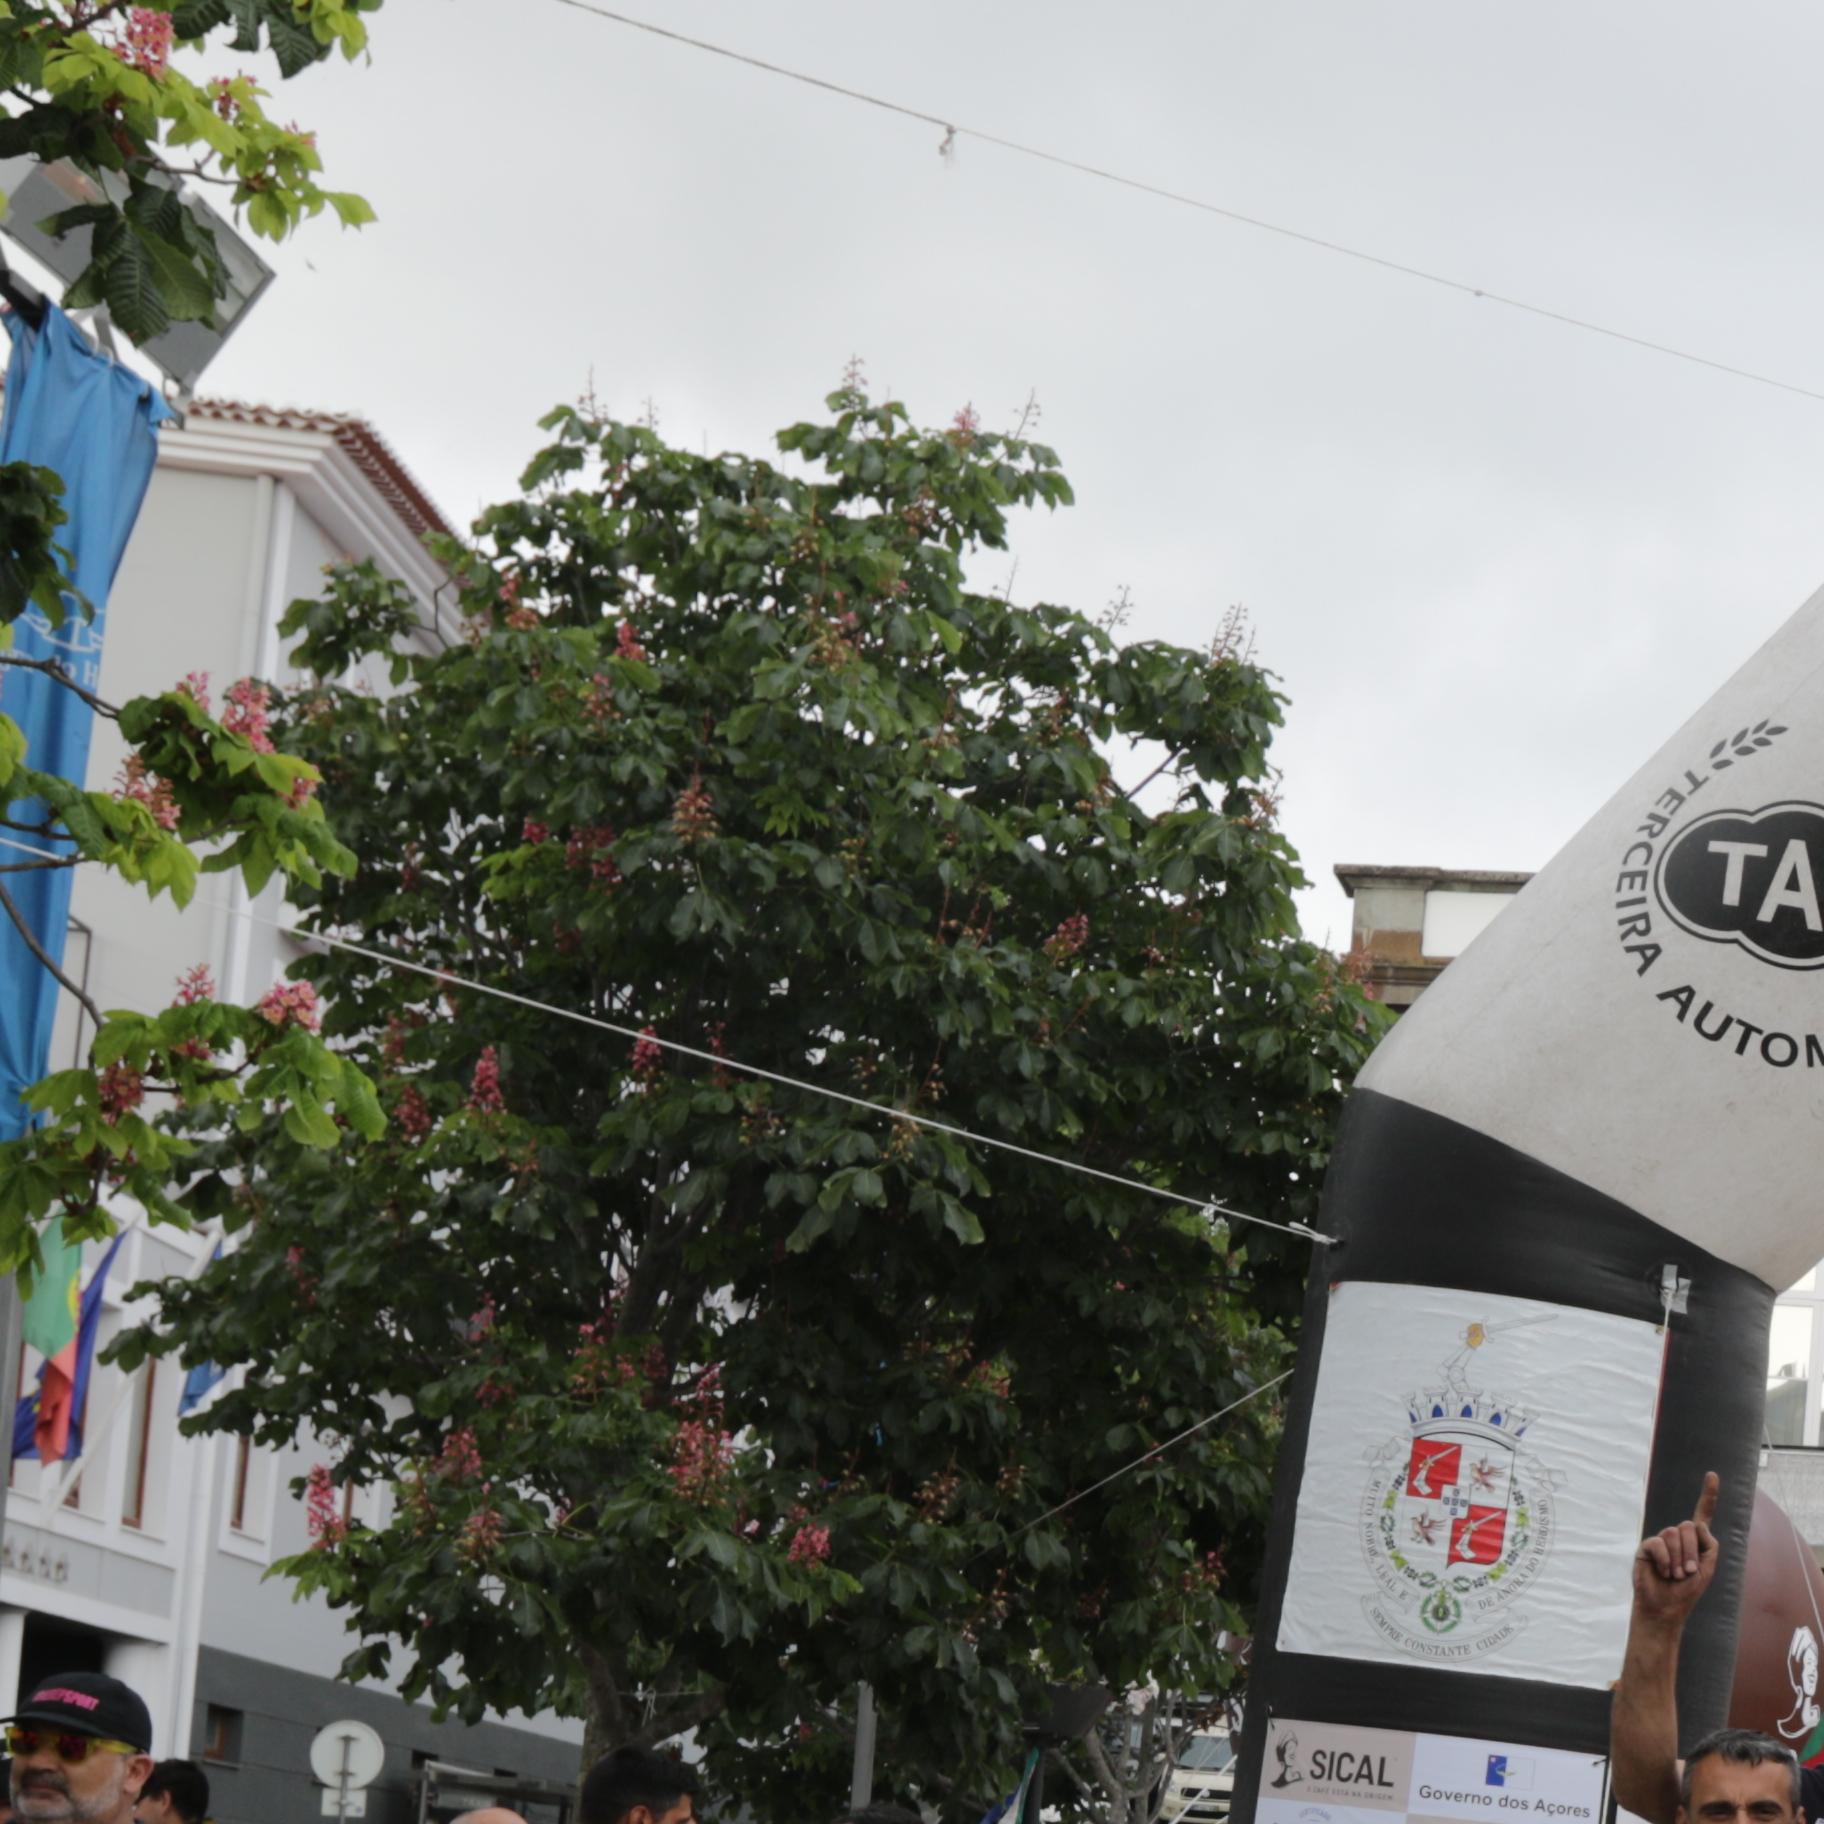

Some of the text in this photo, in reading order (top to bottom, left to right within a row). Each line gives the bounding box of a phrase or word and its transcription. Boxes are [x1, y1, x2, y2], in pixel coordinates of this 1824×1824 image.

[1614, 769, 1710, 977] TERCEIRA
[1309, 1749, 1395, 1788] SICAL
[1418, 1785, 1592, 1819] Governo dos Açores
